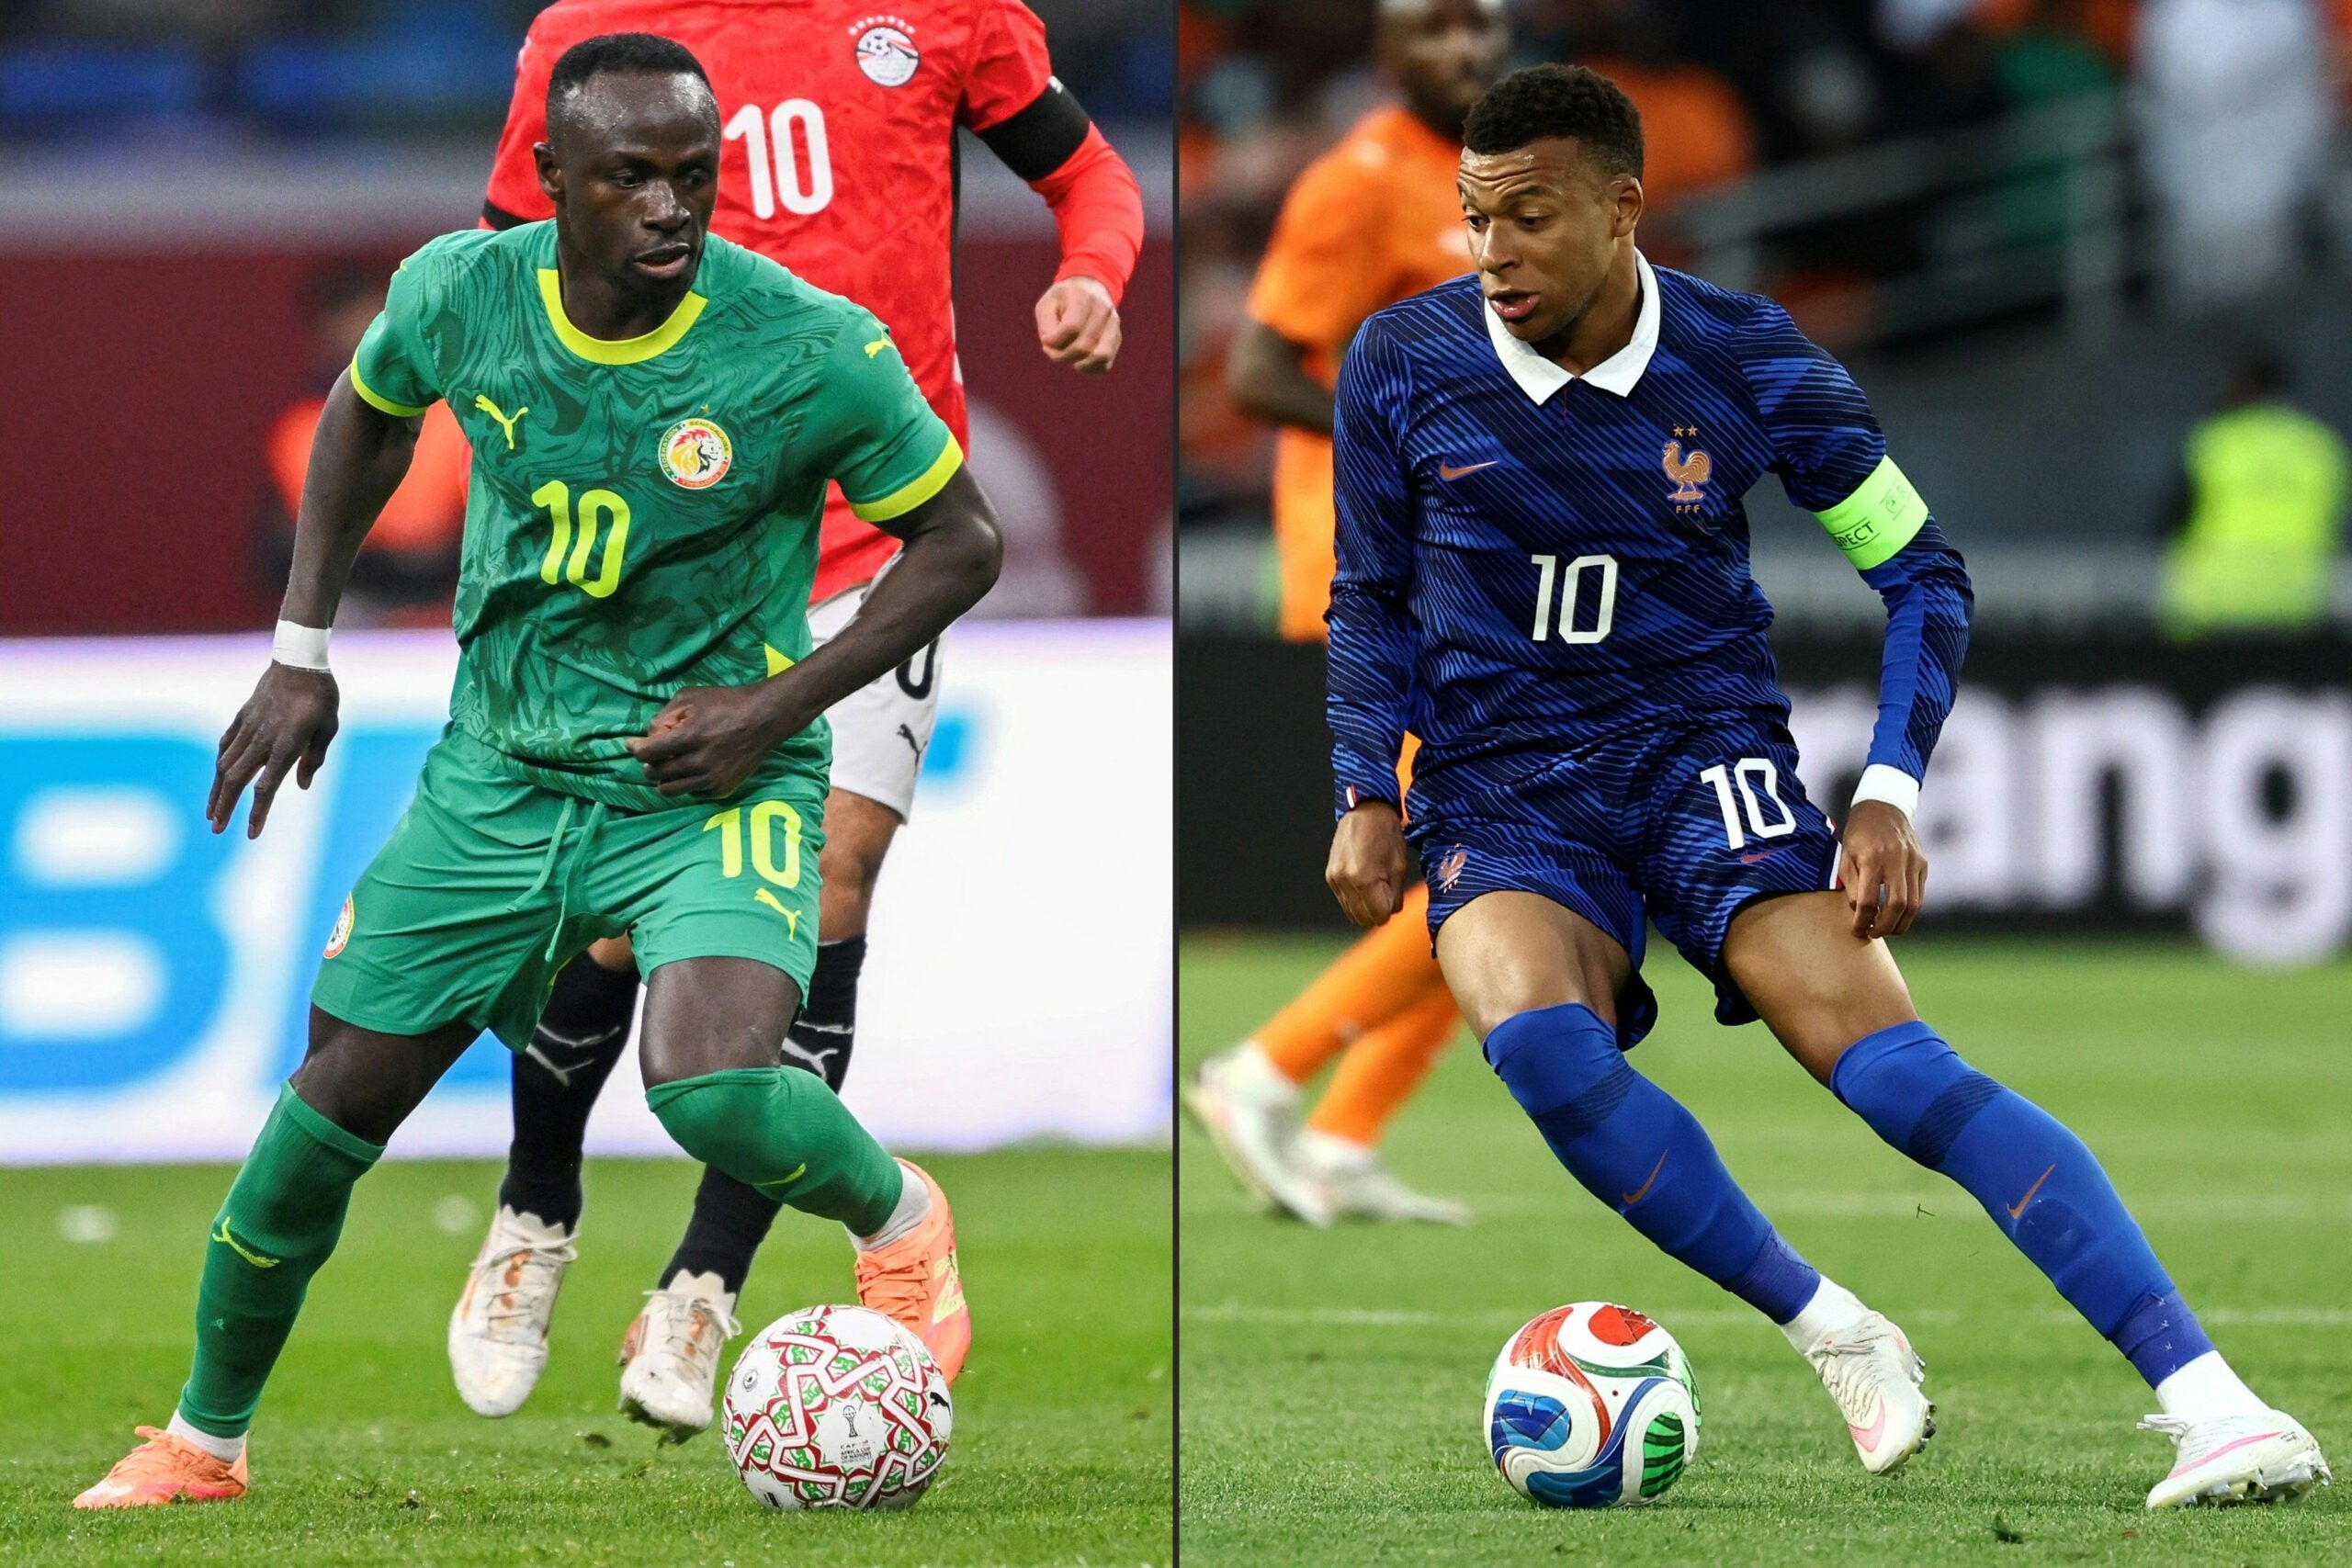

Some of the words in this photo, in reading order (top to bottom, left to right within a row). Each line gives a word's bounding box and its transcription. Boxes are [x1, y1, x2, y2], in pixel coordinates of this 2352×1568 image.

[723, 97, 834, 220] 10
[531, 479, 631, 598] 10
[1675, 504, 1702, 514] FFF
[1531, 554, 1618, 644] 10
[703, 800, 802, 889] 10
[1700, 758, 1797, 851] 10
